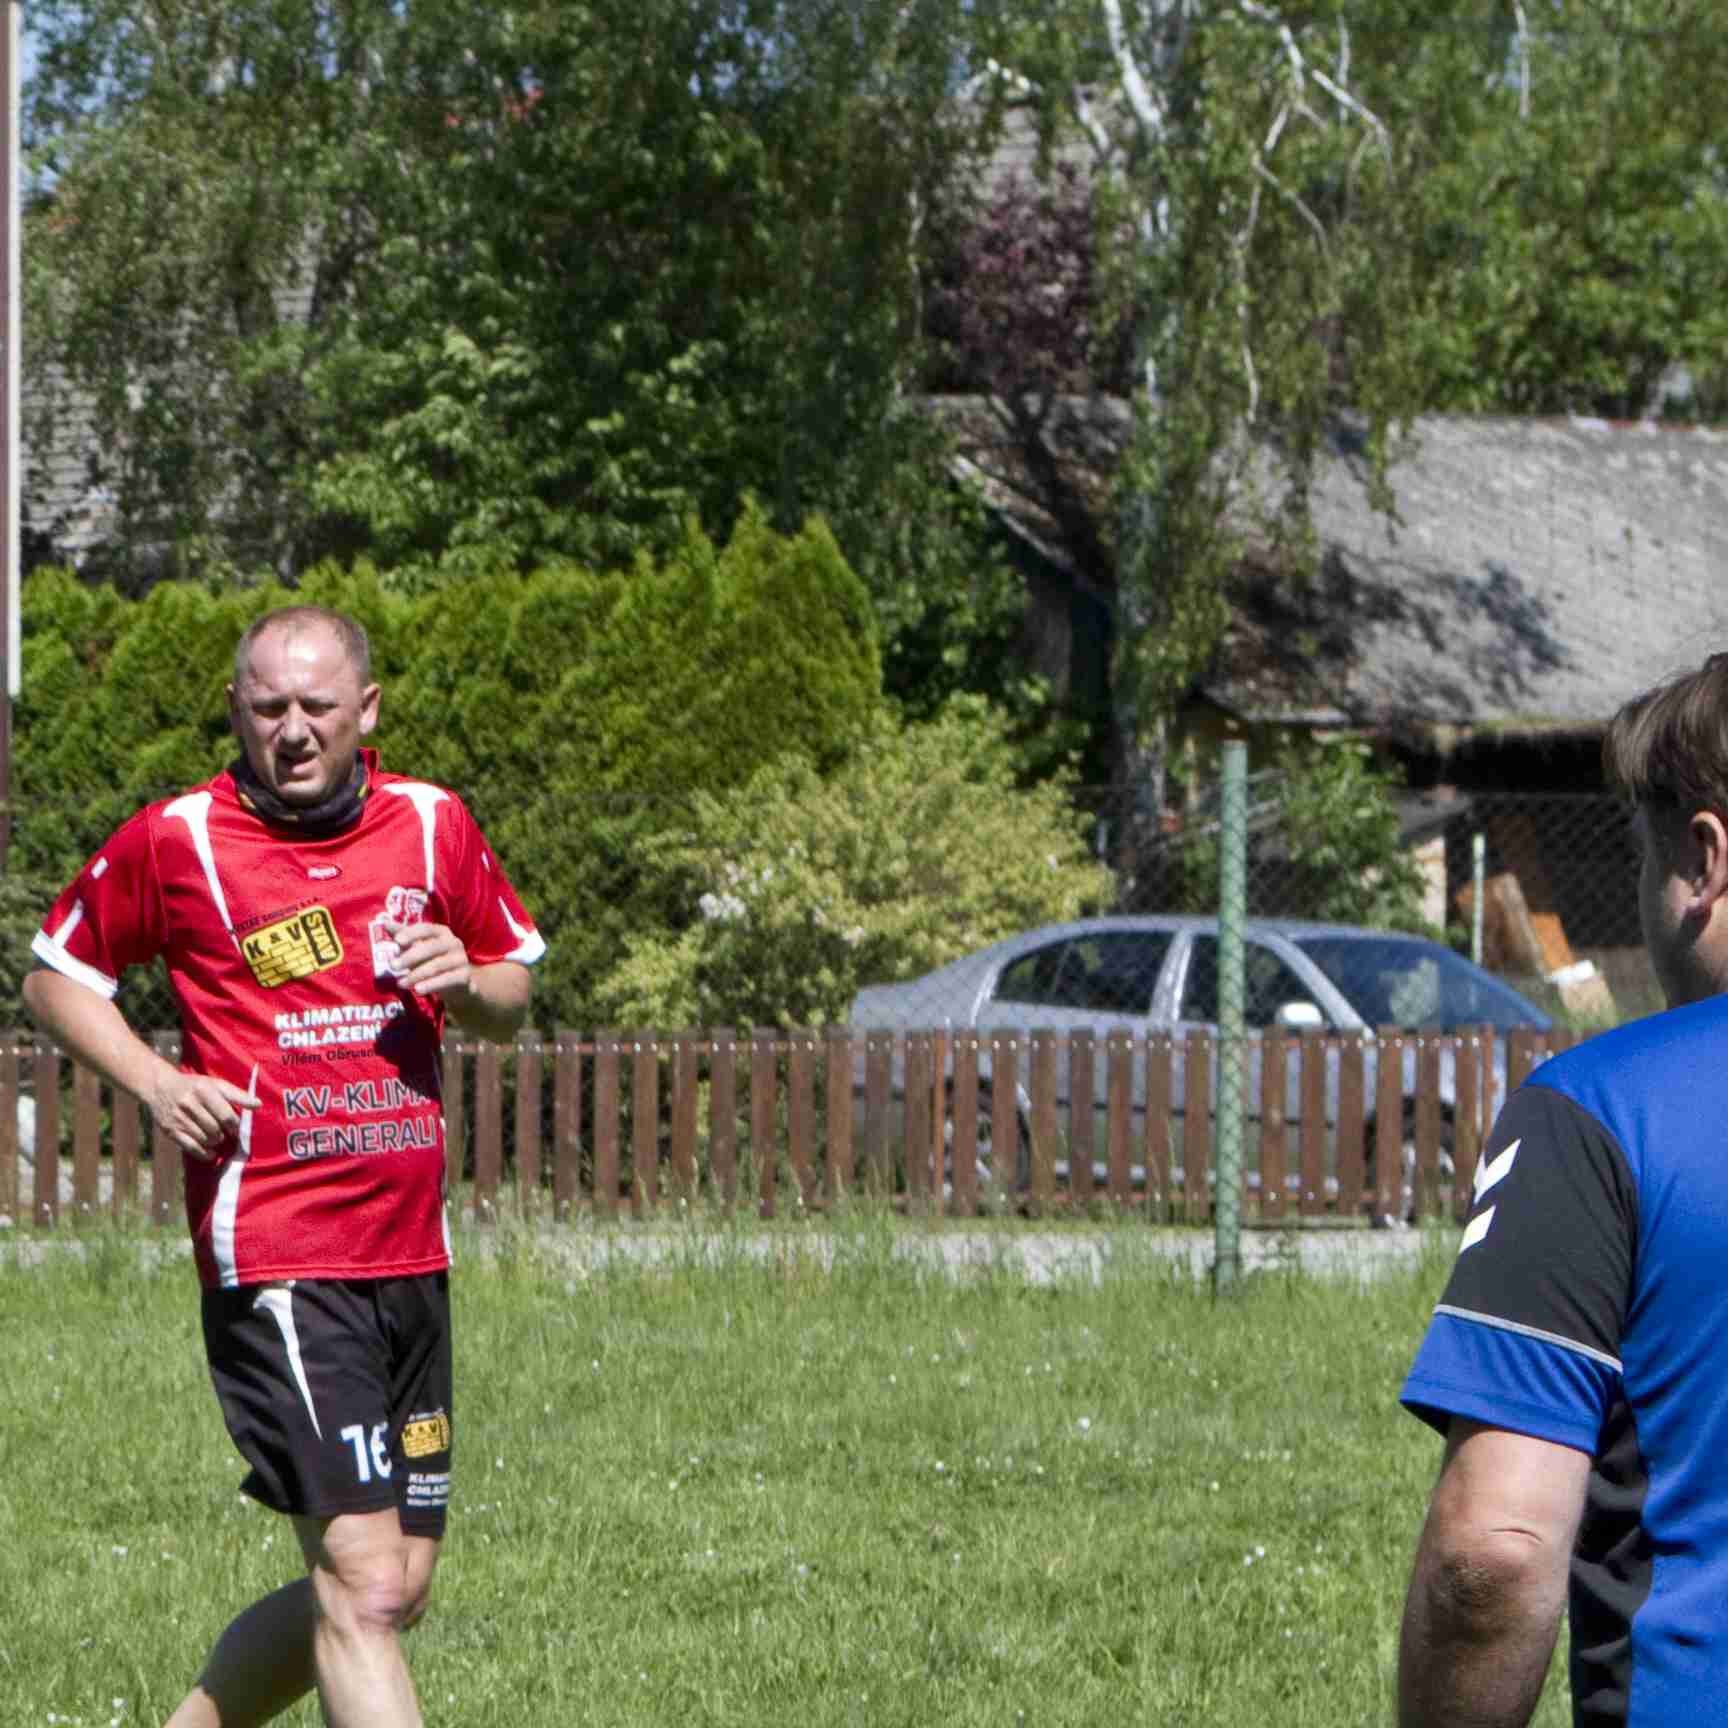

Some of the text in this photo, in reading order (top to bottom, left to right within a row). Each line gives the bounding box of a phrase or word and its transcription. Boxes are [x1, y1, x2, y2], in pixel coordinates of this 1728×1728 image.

[246, 938, 265, 959] K
[287, 922, 303, 941] V
[287, 1115, 437, 1161] GENERALI
